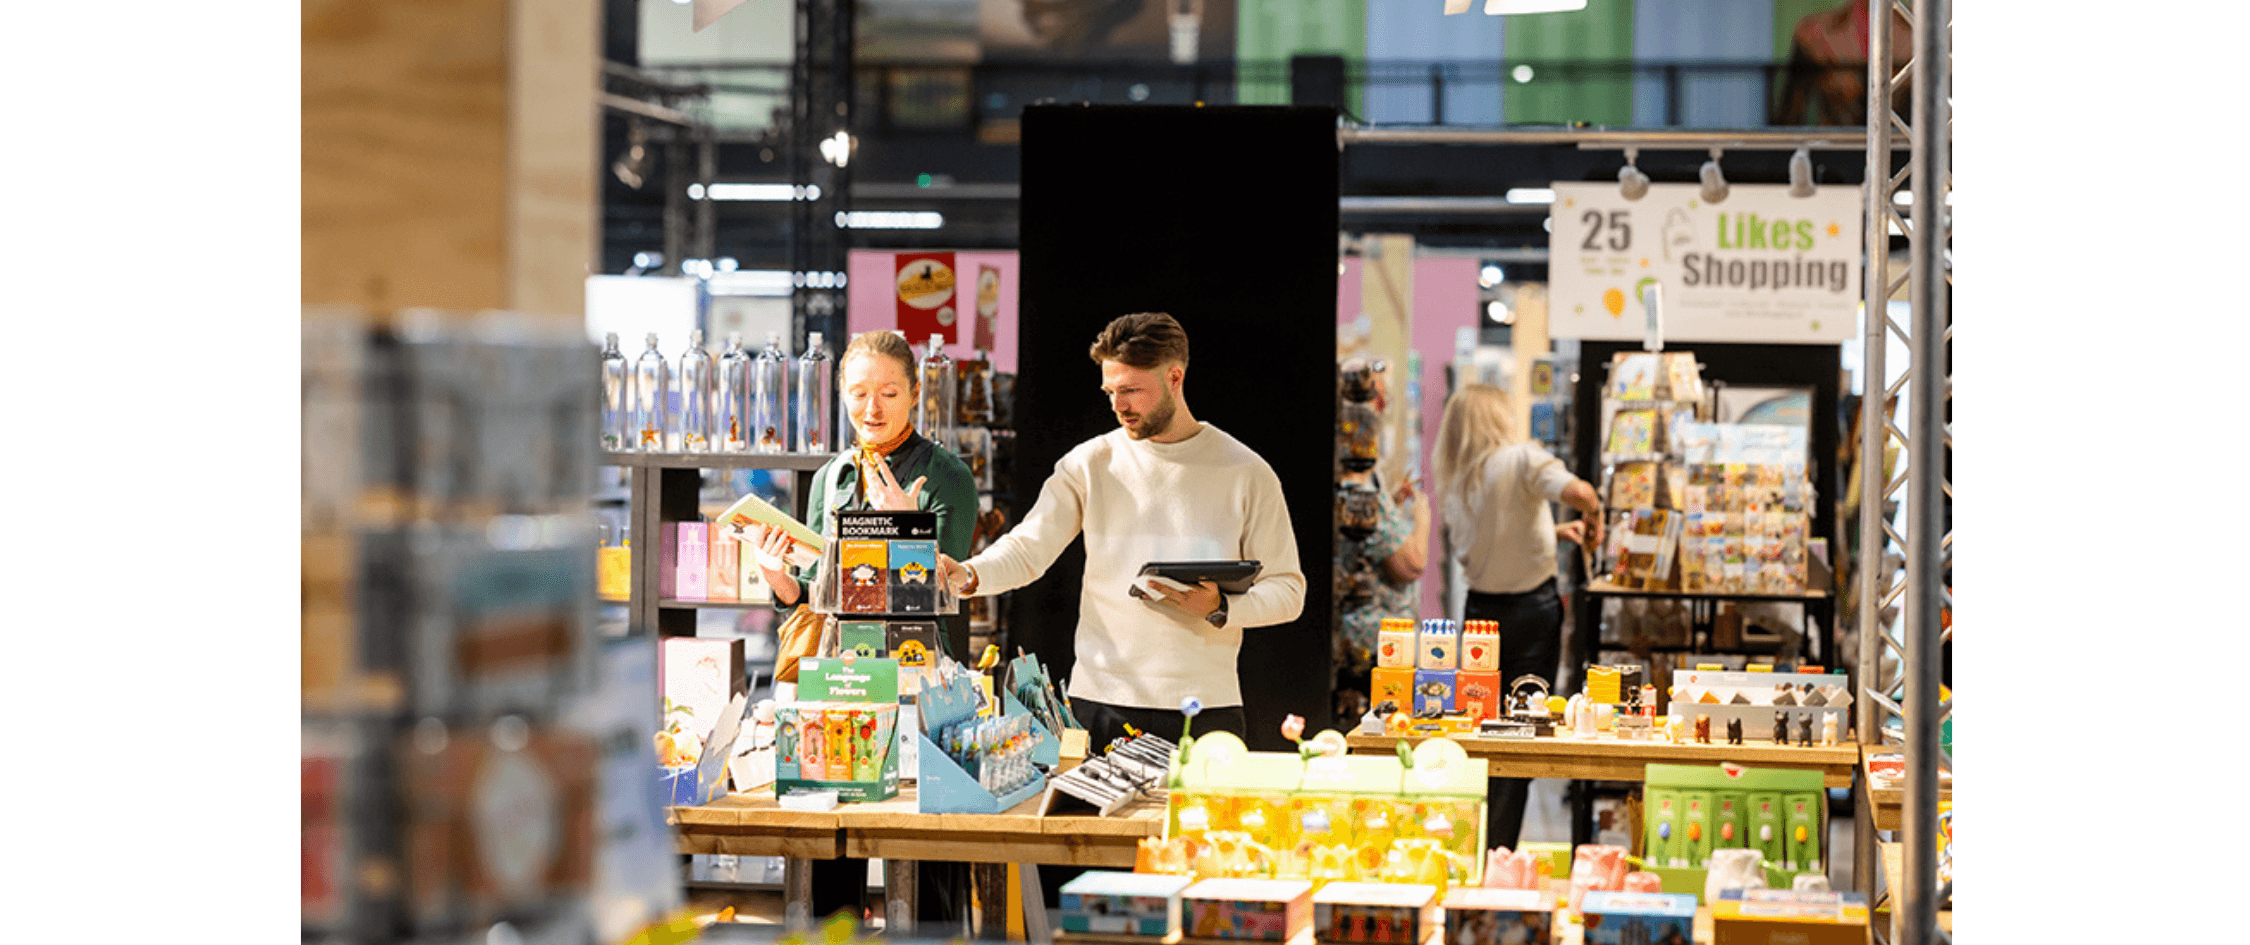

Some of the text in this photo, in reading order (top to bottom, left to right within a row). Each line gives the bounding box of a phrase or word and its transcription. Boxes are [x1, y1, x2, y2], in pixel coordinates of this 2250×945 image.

[1581, 208, 1632, 252] 25
[1717, 212, 1814, 250] Likes
[1682, 253, 1848, 293] Shopping
[842, 517, 893, 526] MAGNETIC
[842, 527, 899, 536] BOOKMARK
[825, 672, 871, 683] Language
[829, 686, 867, 696] Flowers
